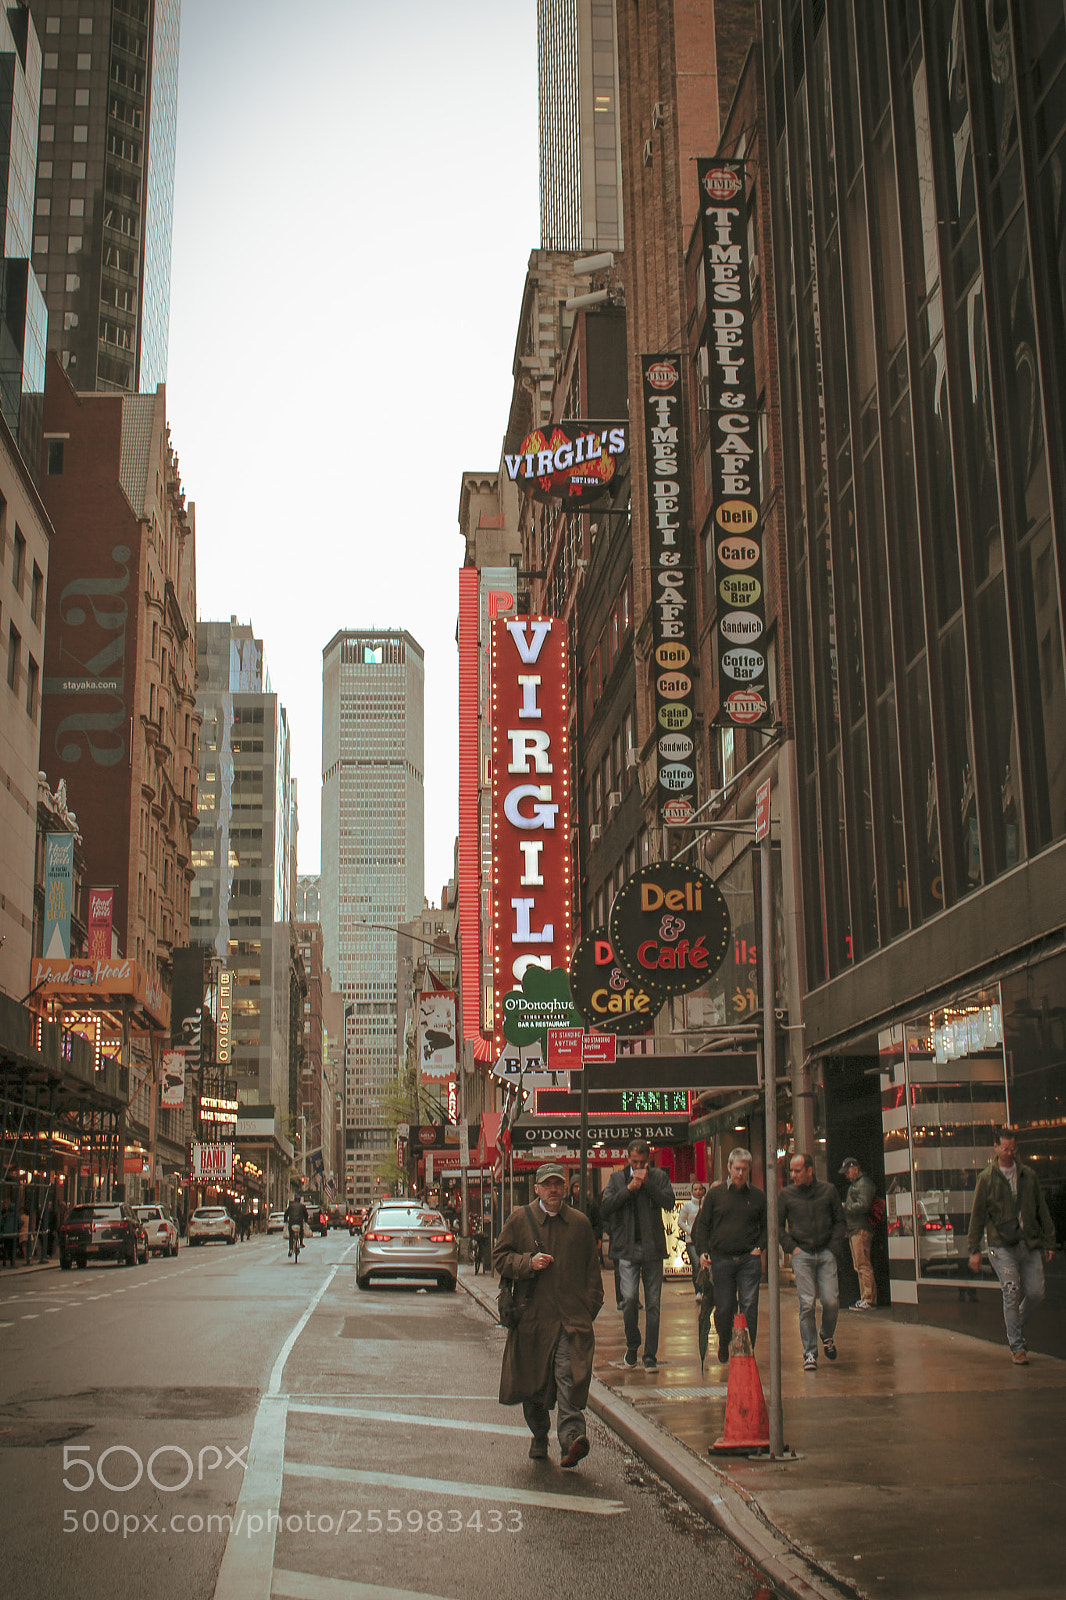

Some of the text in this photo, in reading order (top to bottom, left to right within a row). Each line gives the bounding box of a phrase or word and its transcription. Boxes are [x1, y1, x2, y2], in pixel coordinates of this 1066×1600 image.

[702, 178, 742, 190] TIMES
[705, 206, 753, 496] TIMES DELI & CAFE
[646, 371, 678, 381] TIMES
[505, 428, 625, 480] VIRGIL'S
[649, 395, 687, 638] TIMES DELI & CAFE
[721, 509, 753, 524] Deli
[721, 546, 755, 560] Cafe
[723, 580, 756, 593] Salad
[731, 592, 751, 604] Bar
[722, 619, 763, 634] Sandwich
[659, 650, 685, 661] Deli
[723, 655, 763, 668] Coffee
[733, 667, 754, 678] Bar
[63, 680, 117, 691] stayaka.com
[659, 679, 688, 692] Cafe
[724, 701, 767, 713] TIMES
[661, 708, 688, 719] Salad
[667, 717, 684, 727] Bar
[659, 741, 693, 752] Sandwich
[659, 769, 694, 780] Coffee
[668, 778, 685, 788] Bar
[661, 807, 695, 818] TIMES
[50, 881, 65, 892] WE
[49, 891, 65, 901] GOT
[640, 882, 703, 912] Deli
[49, 901, 65, 910] THE
[47, 909, 69, 920] BEAT
[659, 915, 685, 941] &
[637, 936, 710, 969] Café
[34, 962, 74, 987] Head
[94, 960, 132, 983] Heels
[610, 967, 628, 991] &
[591, 988, 650, 1013] Café
[218, 973, 231, 1062] BELASCO
[645, 1127, 675, 1138] BAR
[201, 1150, 227, 1169] BAND
[599, 1150, 608, 1158] &
